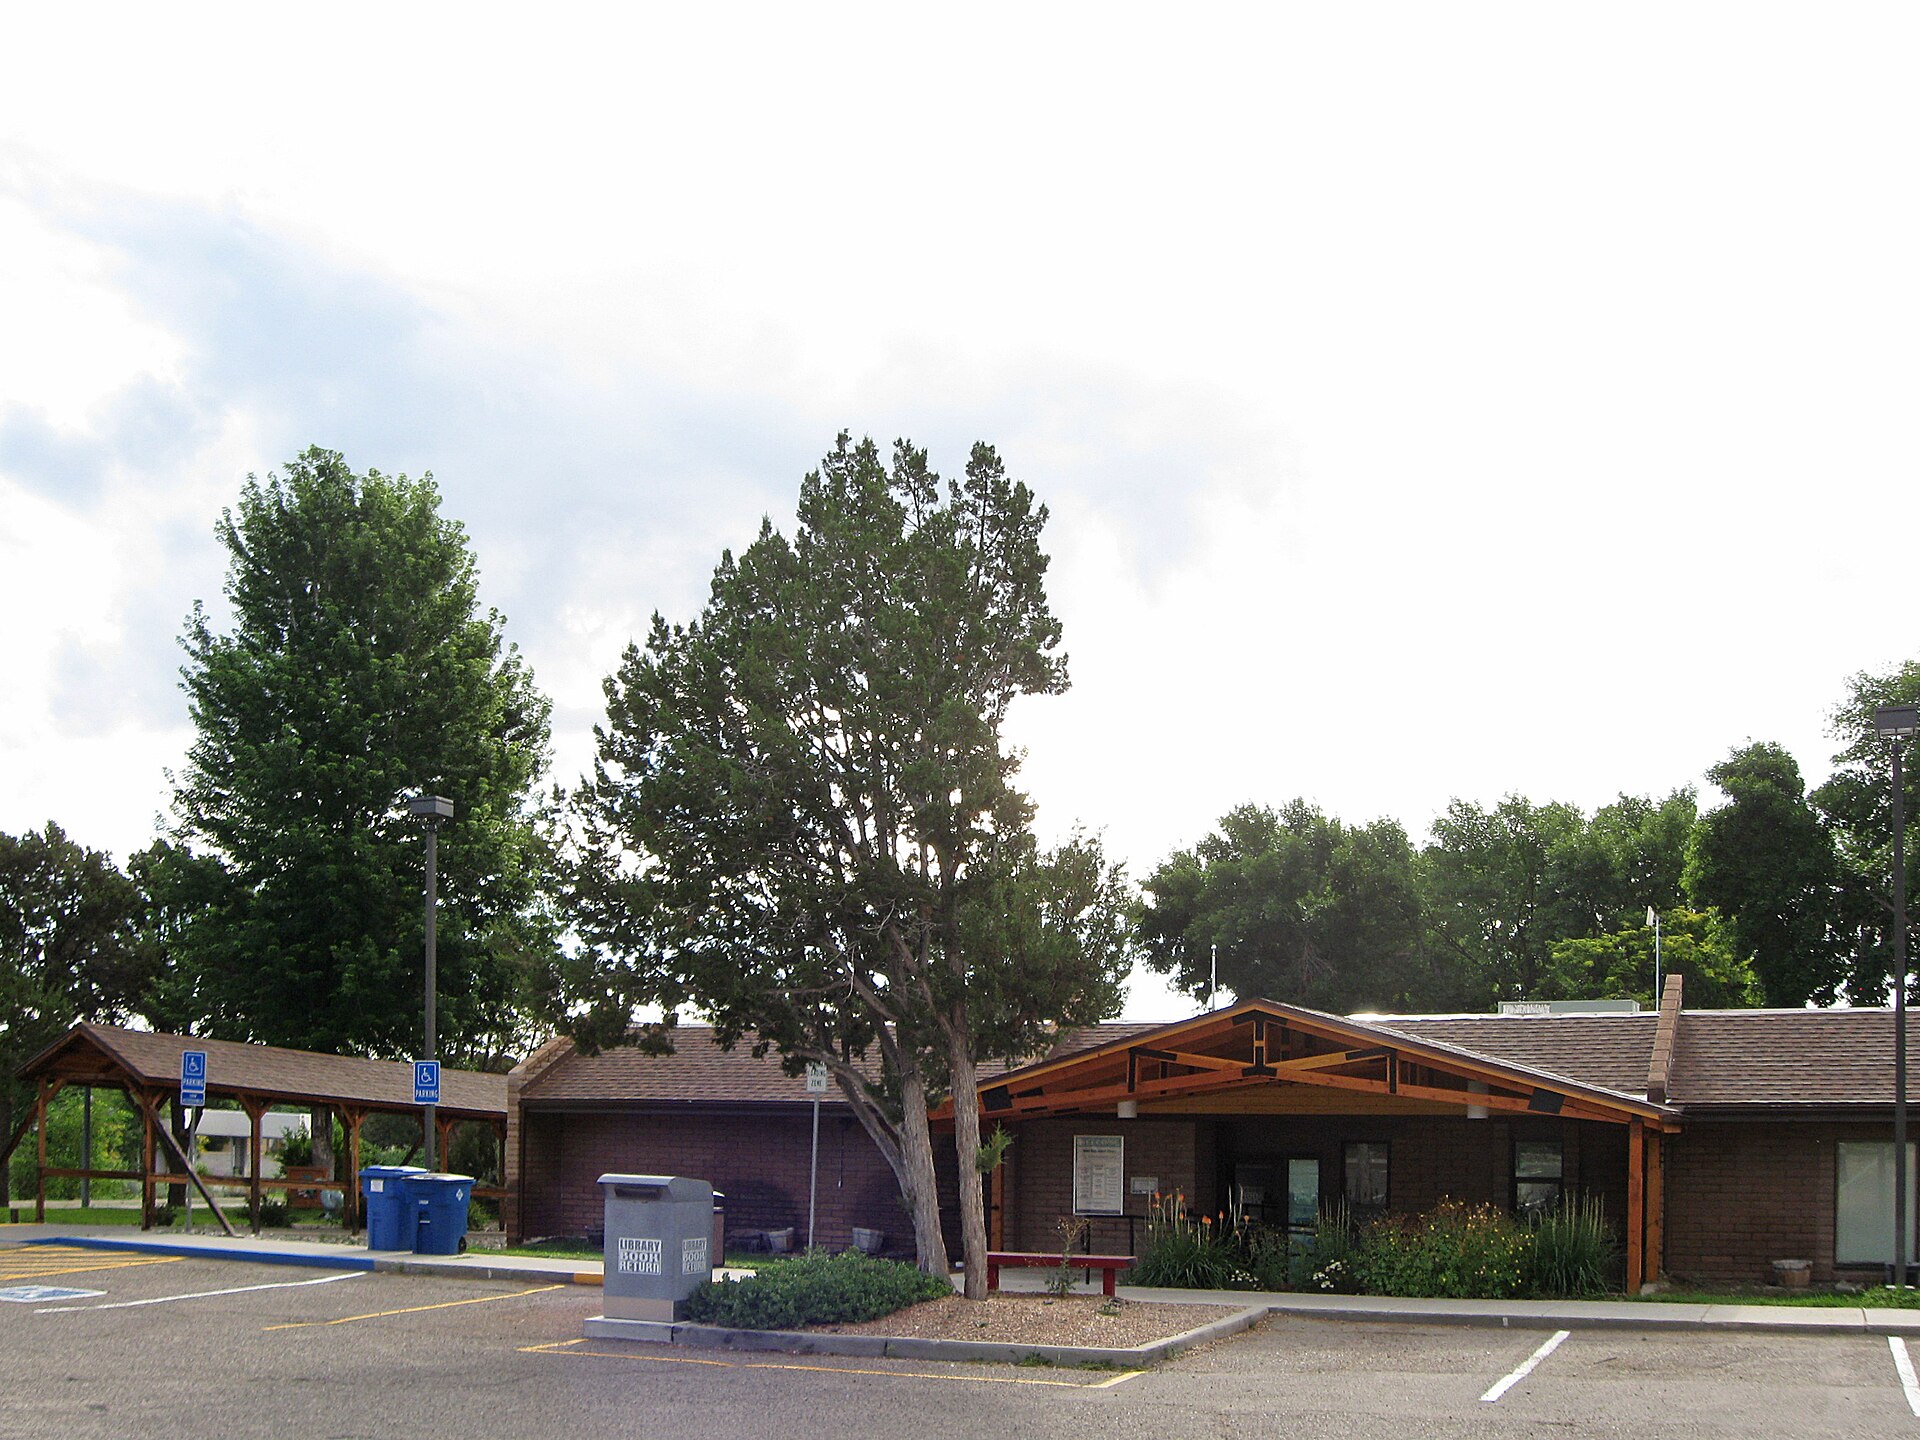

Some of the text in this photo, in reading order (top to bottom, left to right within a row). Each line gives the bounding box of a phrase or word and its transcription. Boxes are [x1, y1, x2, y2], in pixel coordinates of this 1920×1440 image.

[183, 1078, 204, 1087] PARKING
[416, 1089, 438, 1098] PARKING
[620, 1238, 660, 1252] LIBRARY
[683, 1239, 706, 1251] LIBRARY
[620, 1251, 658, 1263] BOOK
[683, 1251, 706, 1262] BOOK
[620, 1260, 659, 1273] RETURN
